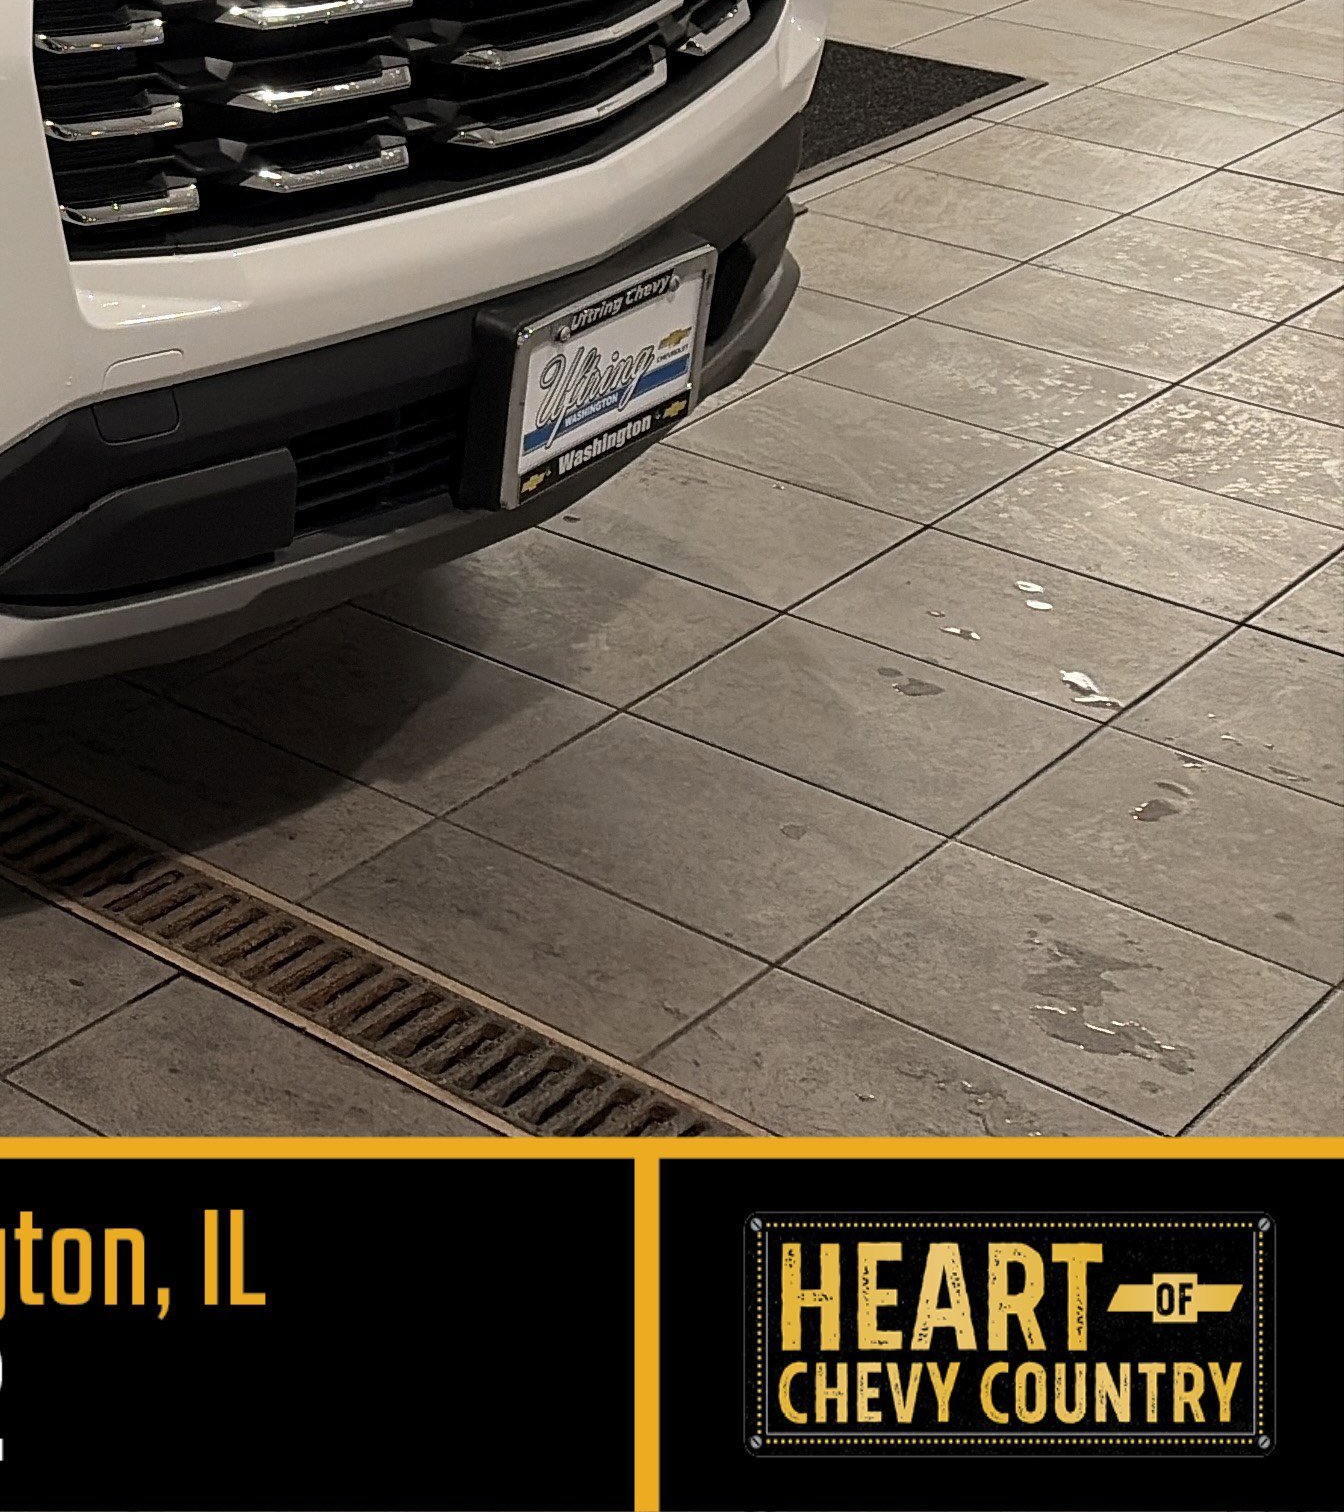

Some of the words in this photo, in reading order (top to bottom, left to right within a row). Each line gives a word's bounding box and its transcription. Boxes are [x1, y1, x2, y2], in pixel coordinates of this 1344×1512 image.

[570, 296, 624, 331] Uftring
[625, 275, 672, 306] Chevy
[535, 345, 655, 449] Uftring
[564, 392, 618, 427] WASHINGTON
[558, 414, 652, 475] Washington
